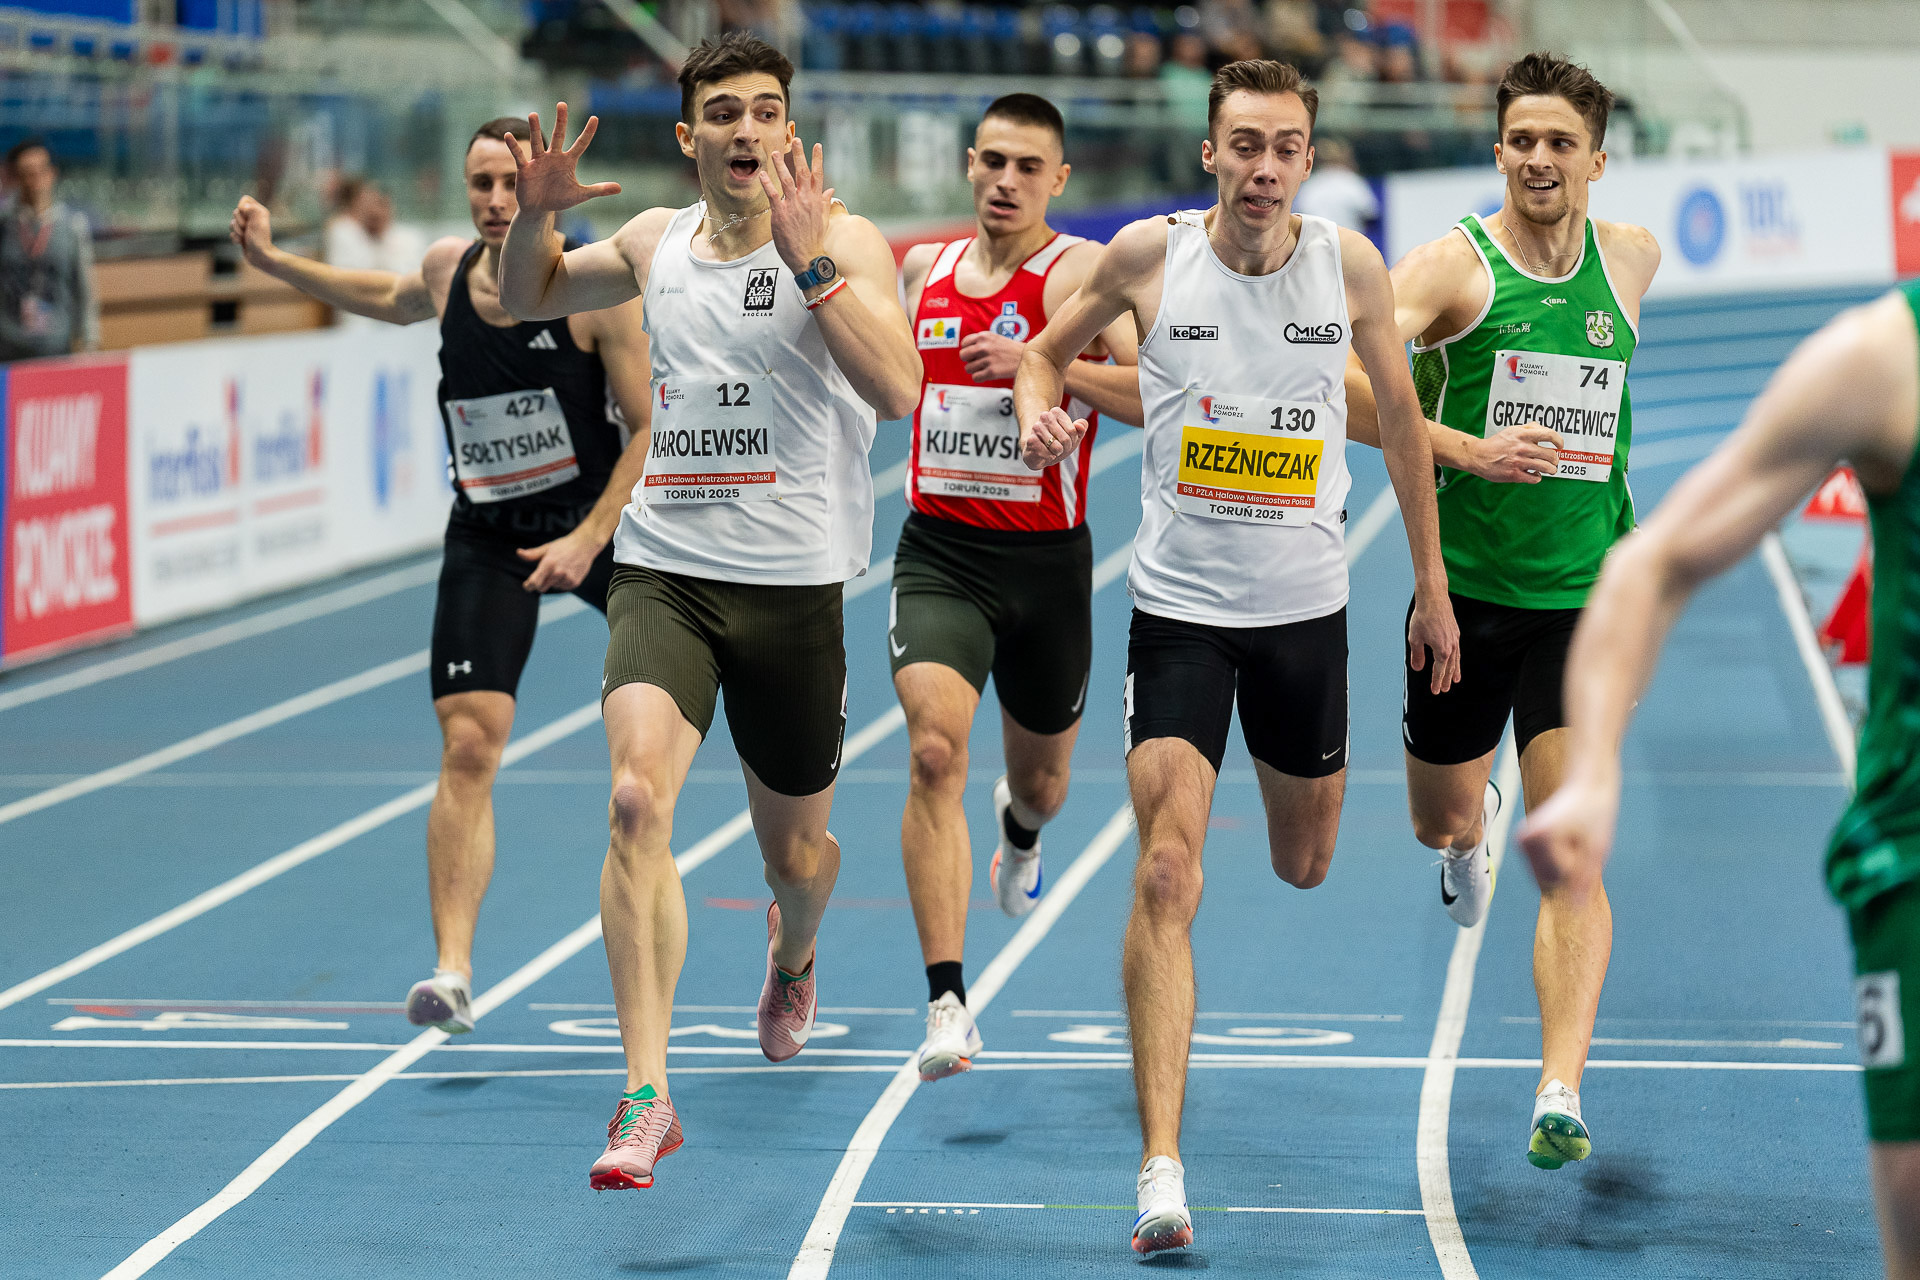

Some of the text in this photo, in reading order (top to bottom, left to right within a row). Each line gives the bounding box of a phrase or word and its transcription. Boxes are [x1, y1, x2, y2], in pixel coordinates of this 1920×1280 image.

[747, 285, 773, 297] AZS
[745, 296, 773, 307] AWF
[1519, 362, 1544, 370] KUJAWY
[1519, 368, 1549, 377] POMORZE
[1579, 364, 1609, 390] 74
[716, 382, 751, 407] 12
[505, 394, 546, 418] 427
[1213, 403, 1239, 412] KUJAWY
[1213, 409, 1244, 418] POMORZE
[1270, 406, 1316, 432] 130
[1492, 400, 1617, 438] GRZEGORZEWICZ
[461, 424, 565, 465] SOŁTYSIAK
[652, 427, 769, 459] KAROLEWSKI
[1185, 441, 1318, 481] RZEŹNICZAK
[1594, 454, 1611, 463] Polski
[1560, 464, 1587, 476] 2025
[668, 474, 696, 483] Halowe
[697, 474, 744, 483] Mistrzostwa
[747, 473, 771, 482] Polski
[664, 486, 740, 499] TORUŃ 2025
[1183, 485, 1311, 506] 69. PZLA Halowe Mistrzostwa Polski
[1209, 503, 1284, 520] TORUŃ 2025
